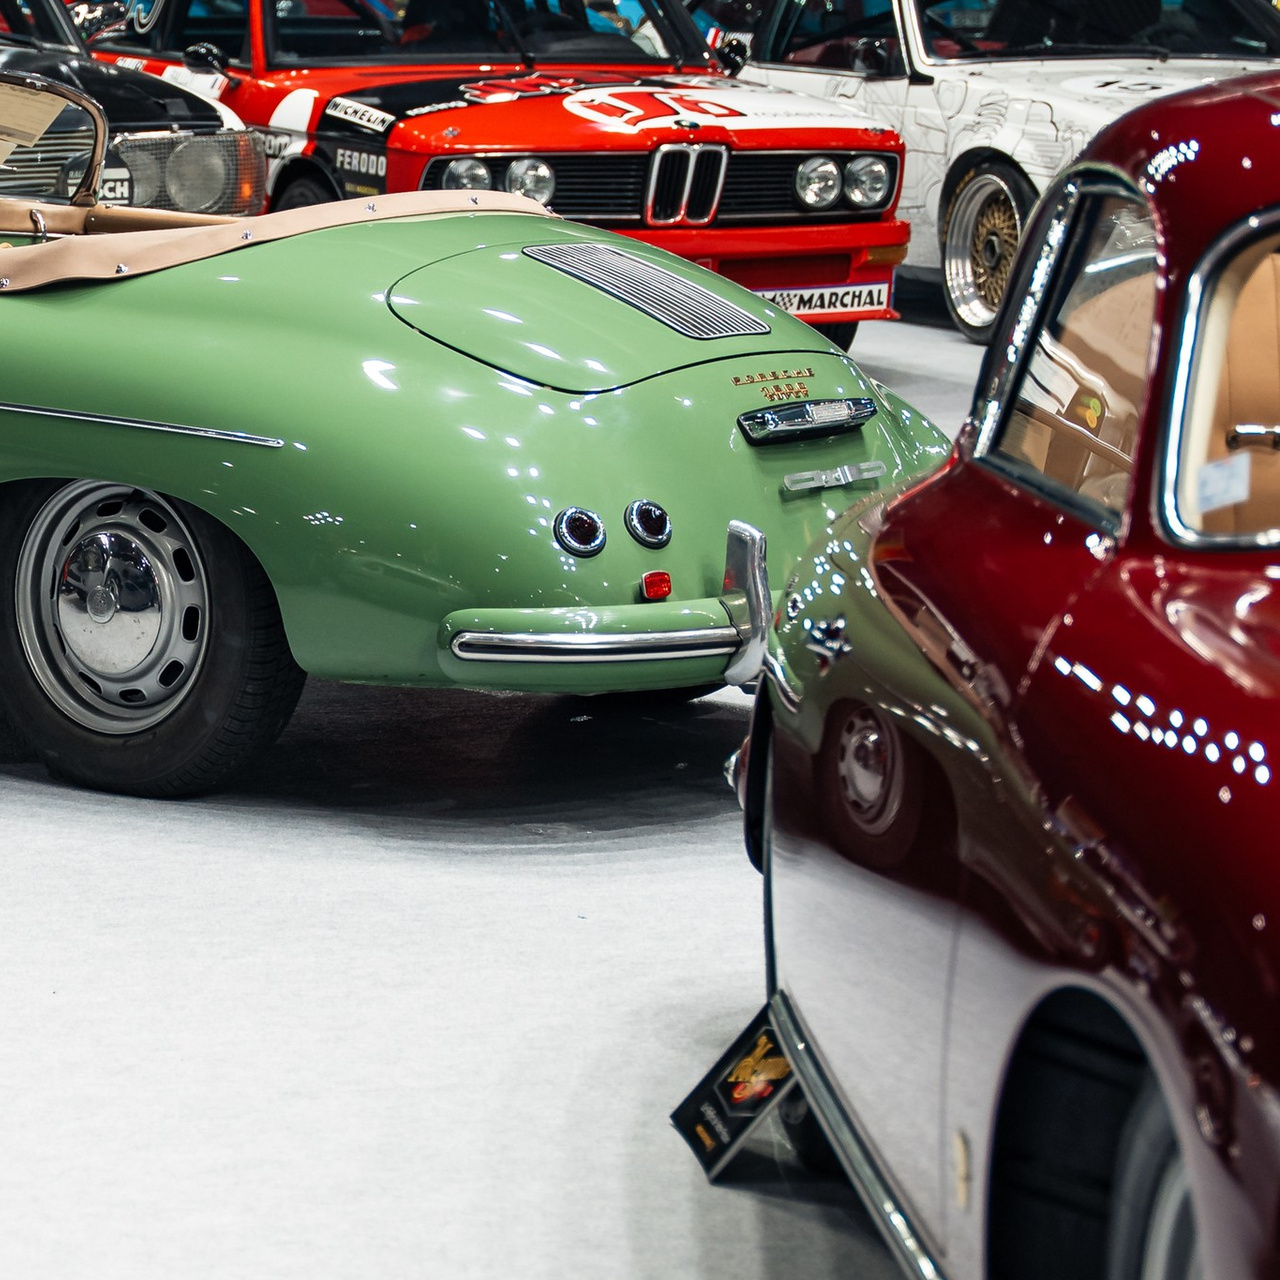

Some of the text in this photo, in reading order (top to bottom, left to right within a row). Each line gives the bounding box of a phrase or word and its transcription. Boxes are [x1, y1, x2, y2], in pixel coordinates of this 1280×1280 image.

[328, 99, 392, 129] MICHELIN
[336, 148, 387, 177] FERODO
[795, 289, 885, 311] MARCHAL
[730, 367, 815, 386] PORSCHE
